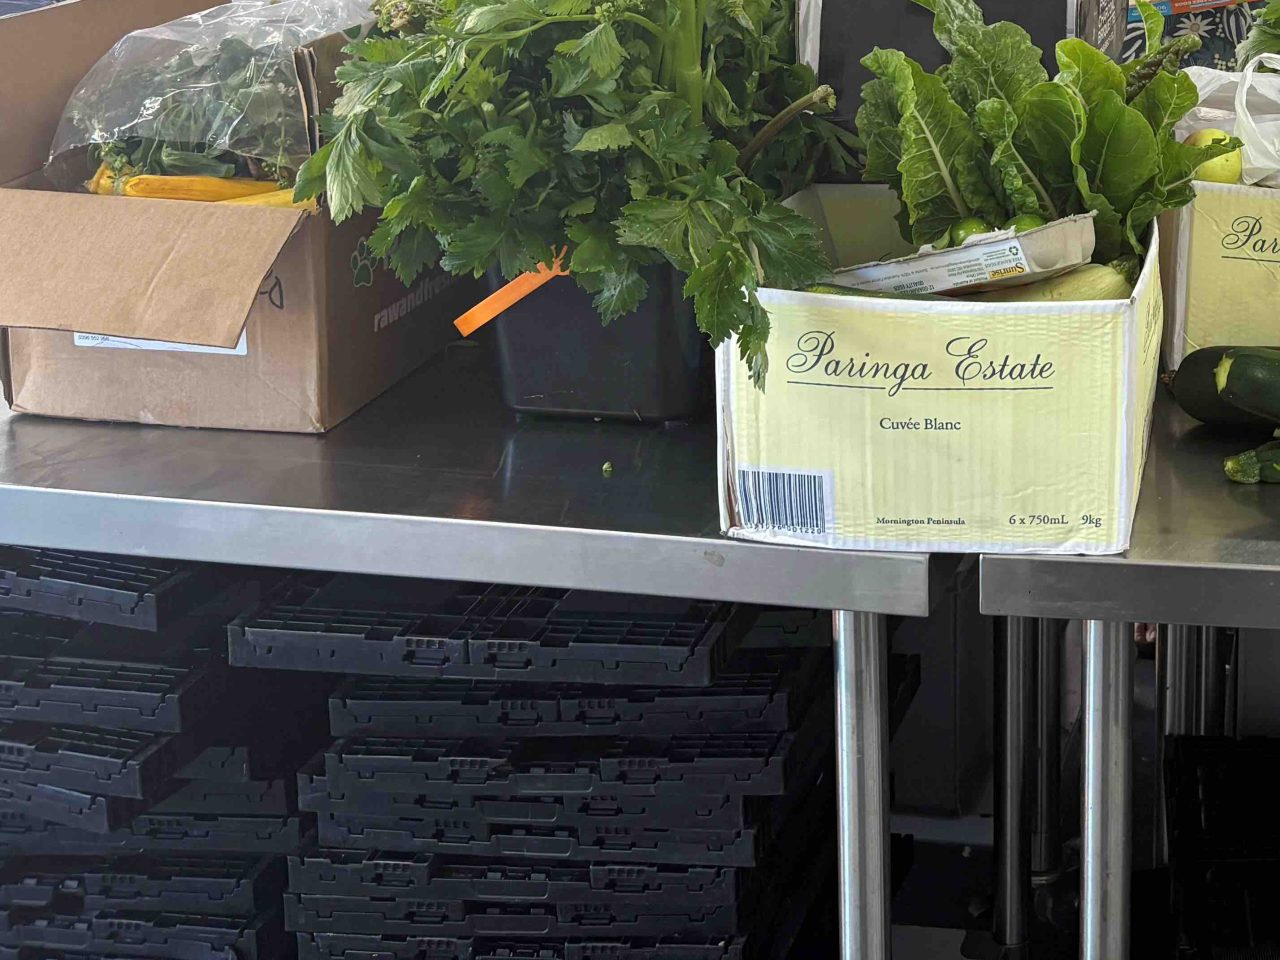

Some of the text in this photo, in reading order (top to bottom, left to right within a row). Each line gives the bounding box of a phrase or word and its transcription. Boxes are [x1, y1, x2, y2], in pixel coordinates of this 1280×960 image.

[988, 261, 1025, 278] Sunrise
[786, 330, 1056, 397] Paringa Estate
[879, 417, 962, 431] Cuvée Blanc
[876, 513, 1102, 527] Mornington Peninsula 6 x 750mL 9kg
